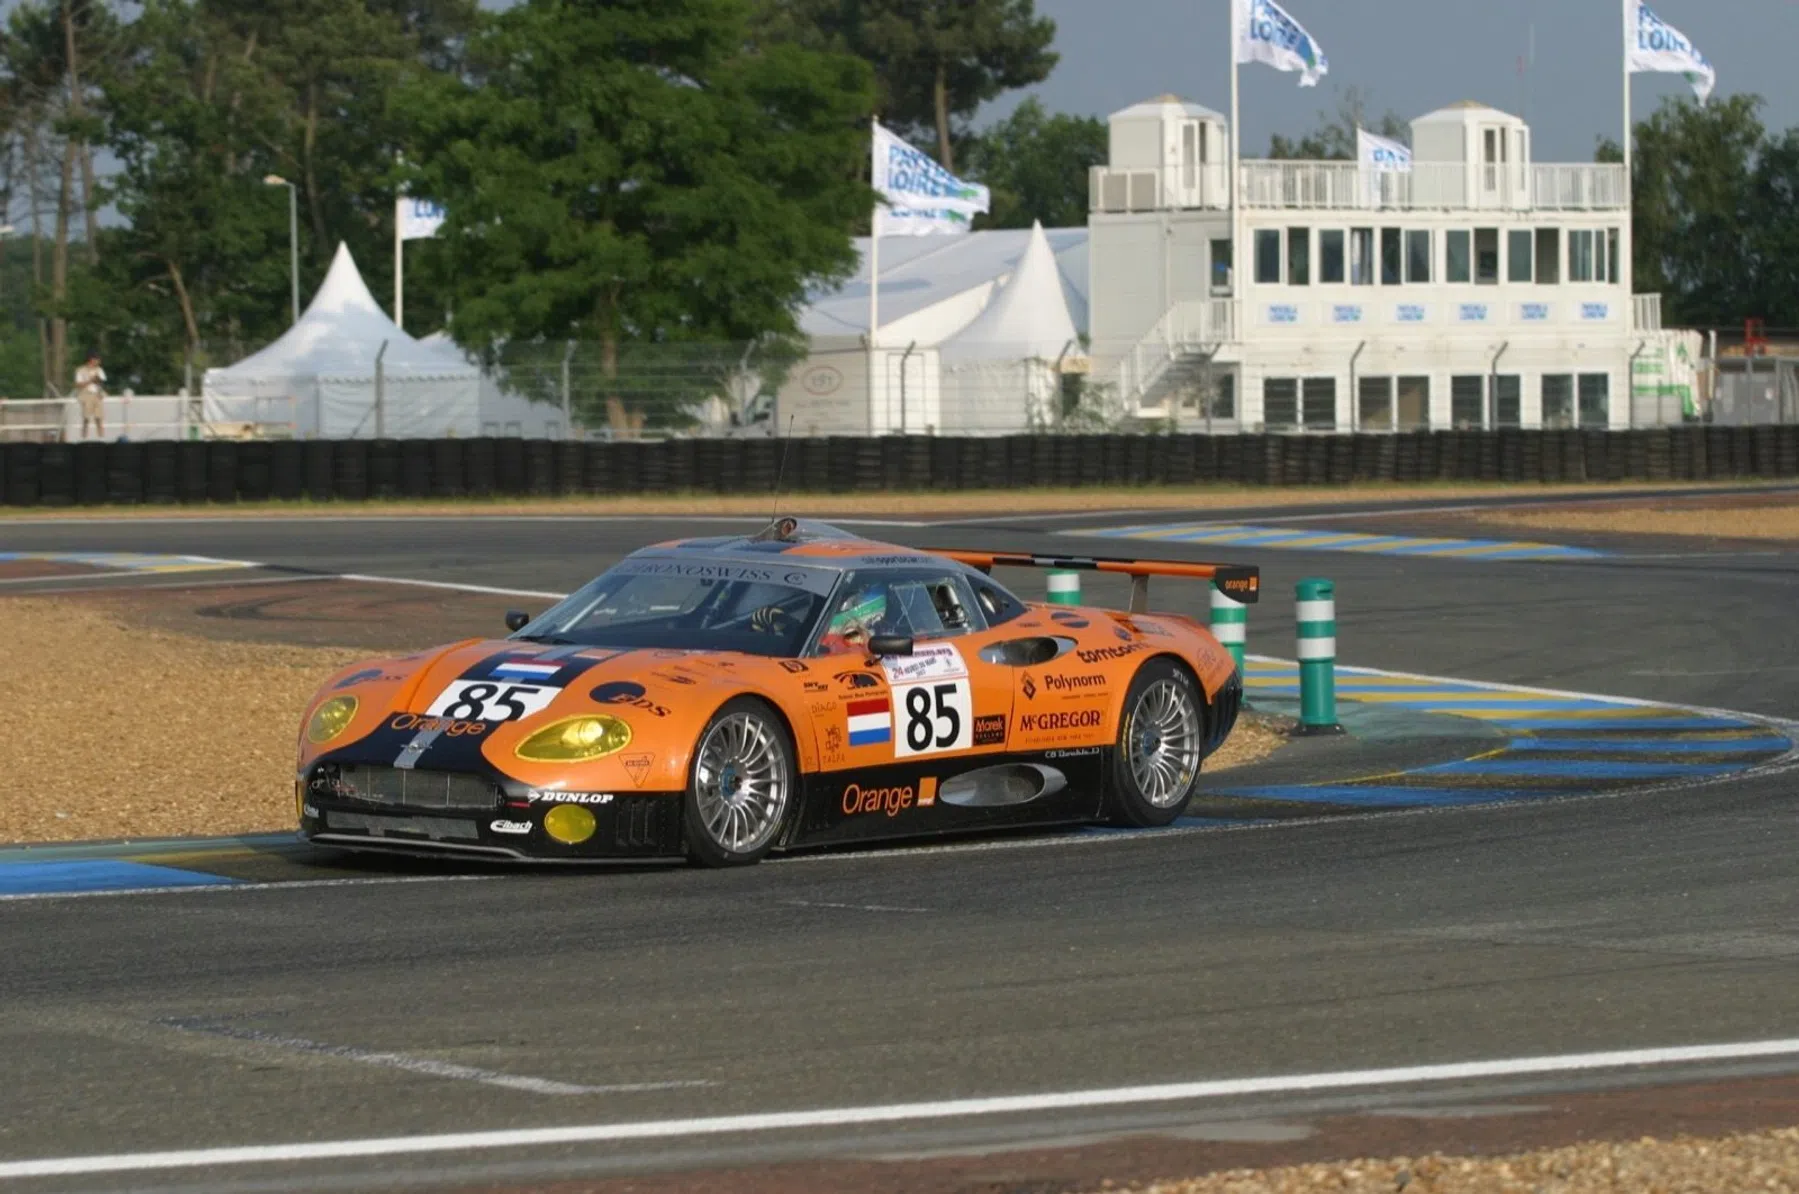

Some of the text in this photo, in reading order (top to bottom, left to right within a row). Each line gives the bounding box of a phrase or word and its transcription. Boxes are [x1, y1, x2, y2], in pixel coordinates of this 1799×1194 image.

[1044, 673, 1106, 691] Polynorm
[443, 683, 542, 722] 85
[391, 713, 487, 737] Orange
[906, 683, 961, 751] 85
[540, 791, 614, 804] DUNLOP
[842, 784, 913, 817] Orange
